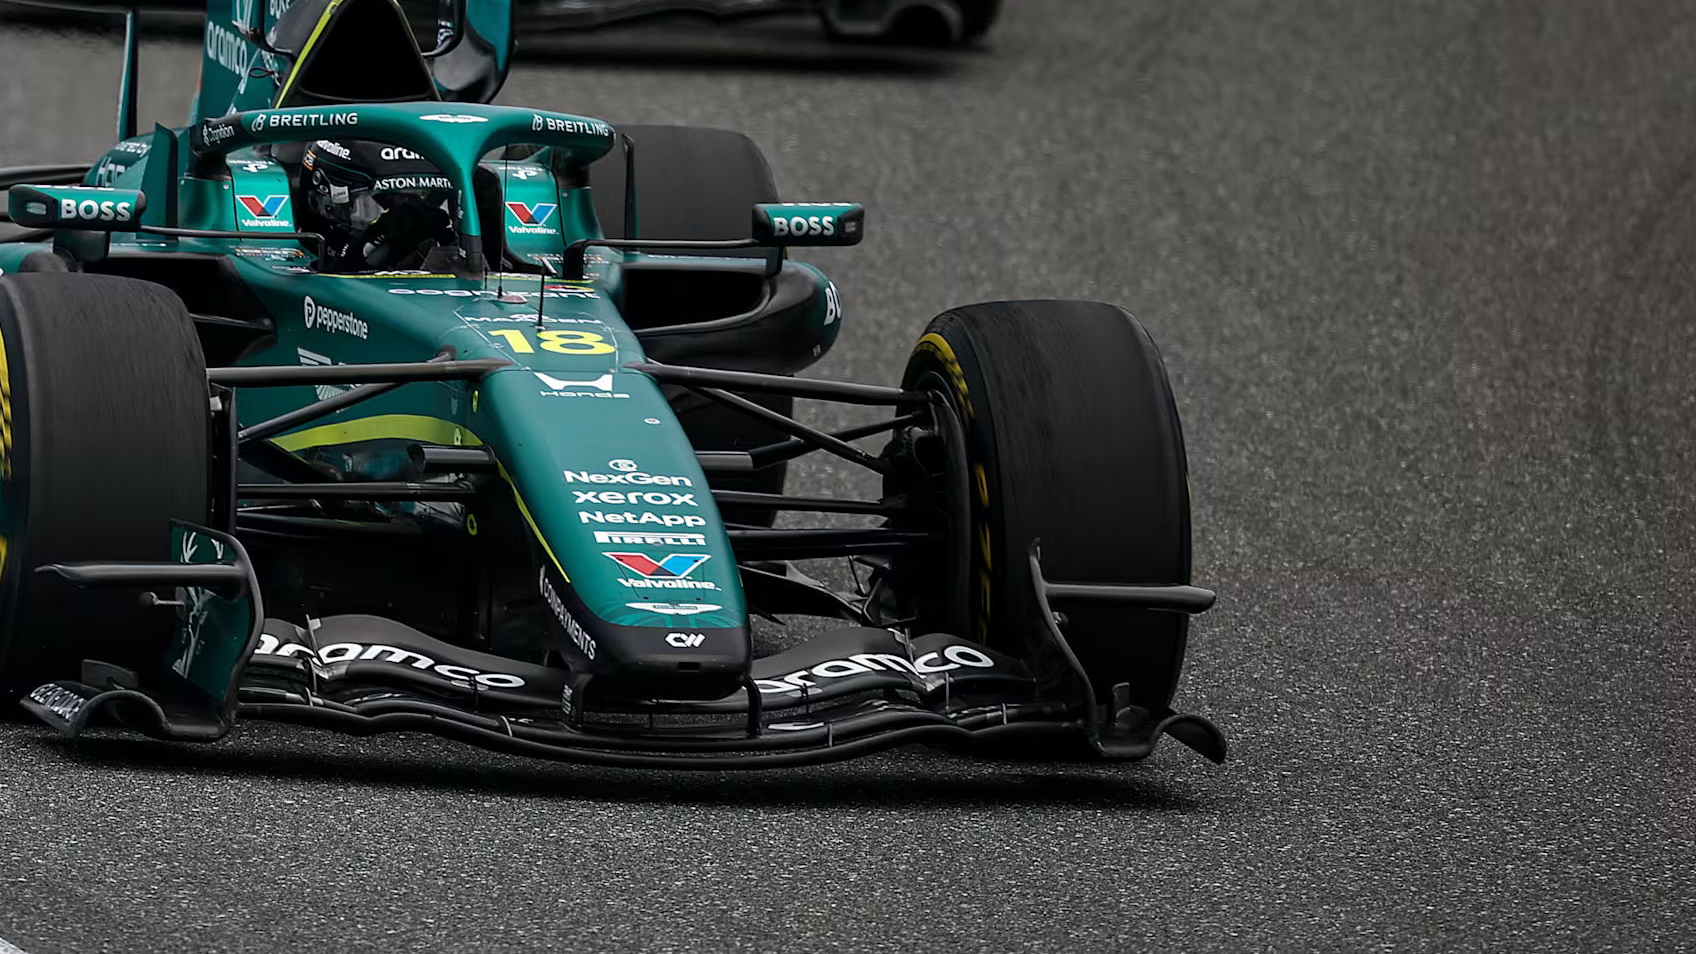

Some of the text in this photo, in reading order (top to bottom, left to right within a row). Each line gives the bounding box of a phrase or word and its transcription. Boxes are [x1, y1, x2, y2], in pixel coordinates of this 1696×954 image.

[269, 112, 358, 128] BREITLING
[547, 117, 610, 138] BREITLING
[374, 178, 416, 190] ASTON
[61, 198, 131, 222] BOSS
[773, 216, 835, 237] BOSS
[316, 305, 369, 341] pepperstone
[488, 329, 617, 355] 18
[563, 470, 694, 487] NexGen
[572, 490, 699, 507] xerox
[578, 511, 707, 528] NetApp
[593, 531, 706, 546] PIRELLI
[254, 633, 526, 689] aramco
[743, 645, 996, 695] aramco
